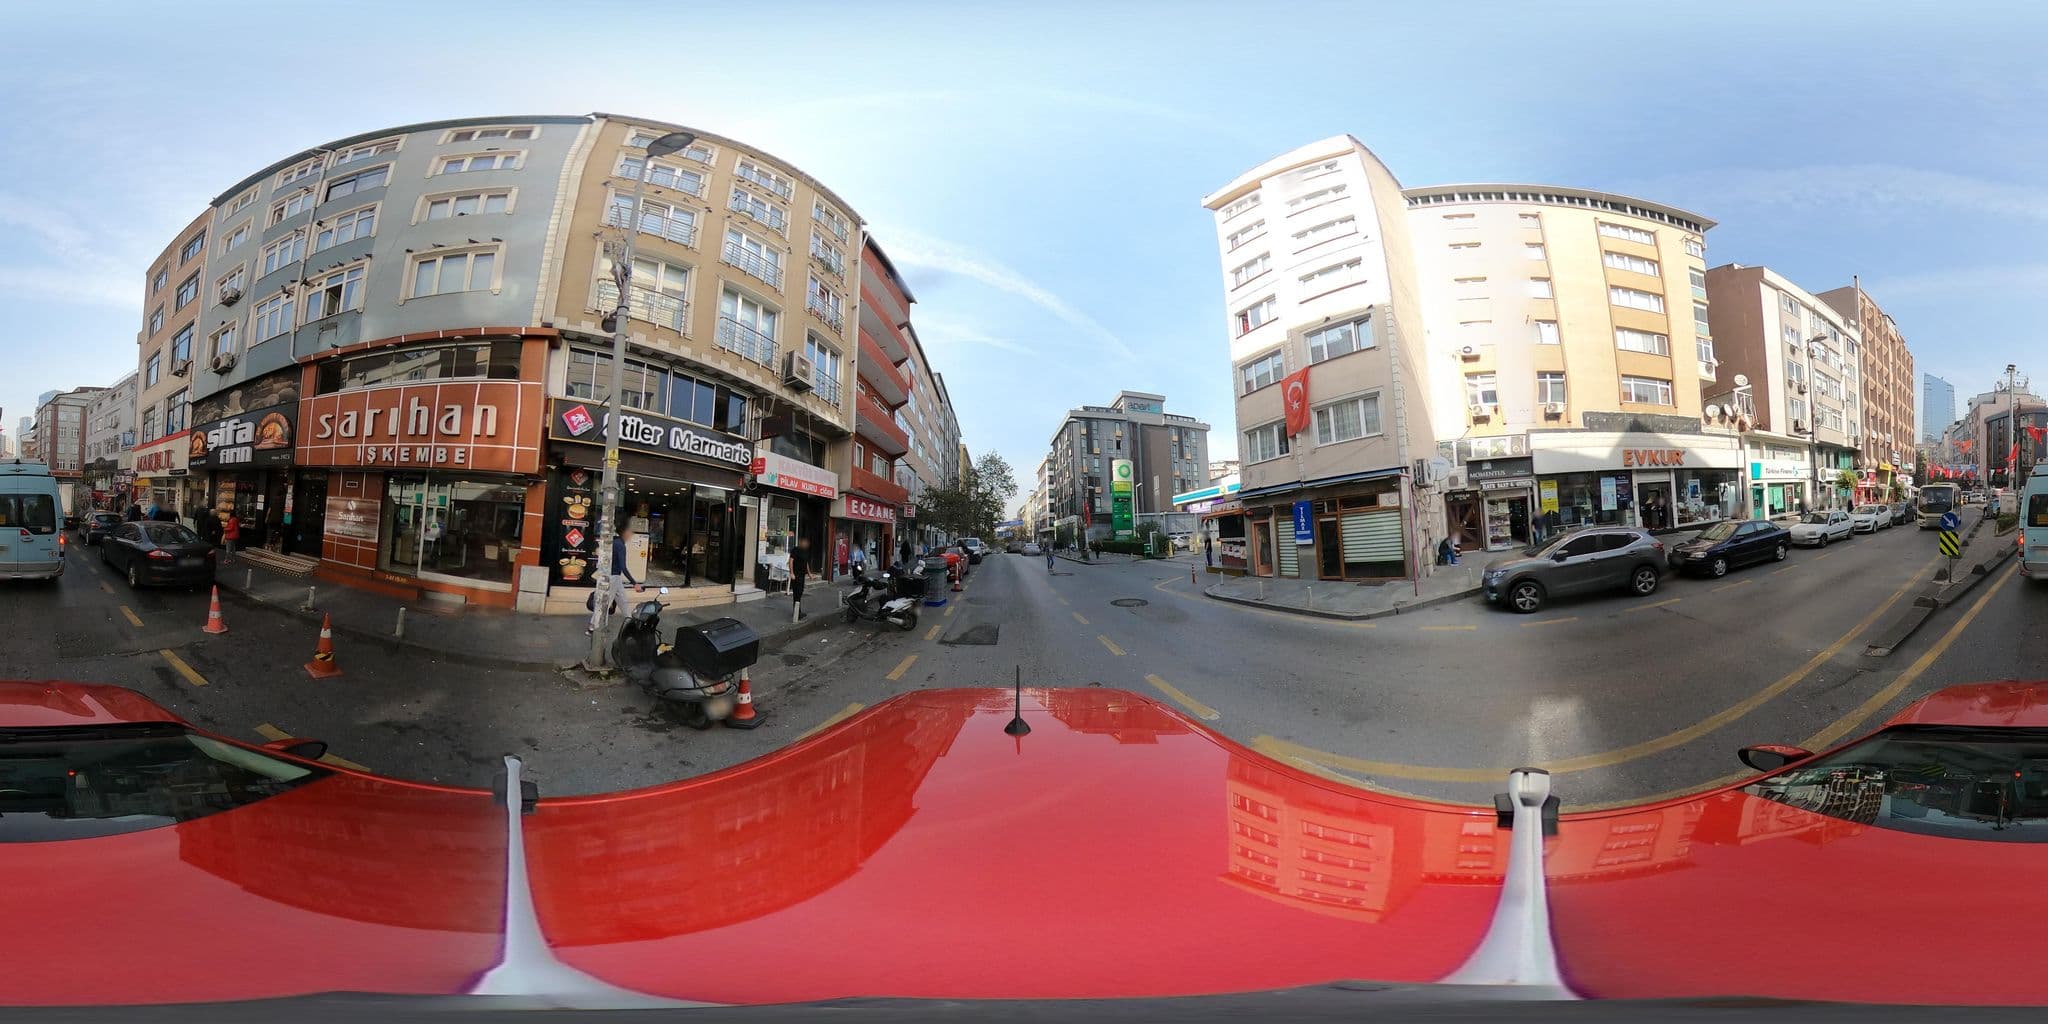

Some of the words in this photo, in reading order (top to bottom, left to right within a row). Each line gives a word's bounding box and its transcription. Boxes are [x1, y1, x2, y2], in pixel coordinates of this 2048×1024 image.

[316, 396, 497, 439] sarıhan
[207, 418, 255, 452] şifa
[602, 412, 665, 445] tiler
[669, 427, 751, 466] Marmaris
[136, 449, 175, 472] MAKBUL
[1623, 449, 1686, 467] EVKUR
[851, 499, 894, 520] ECZANE
